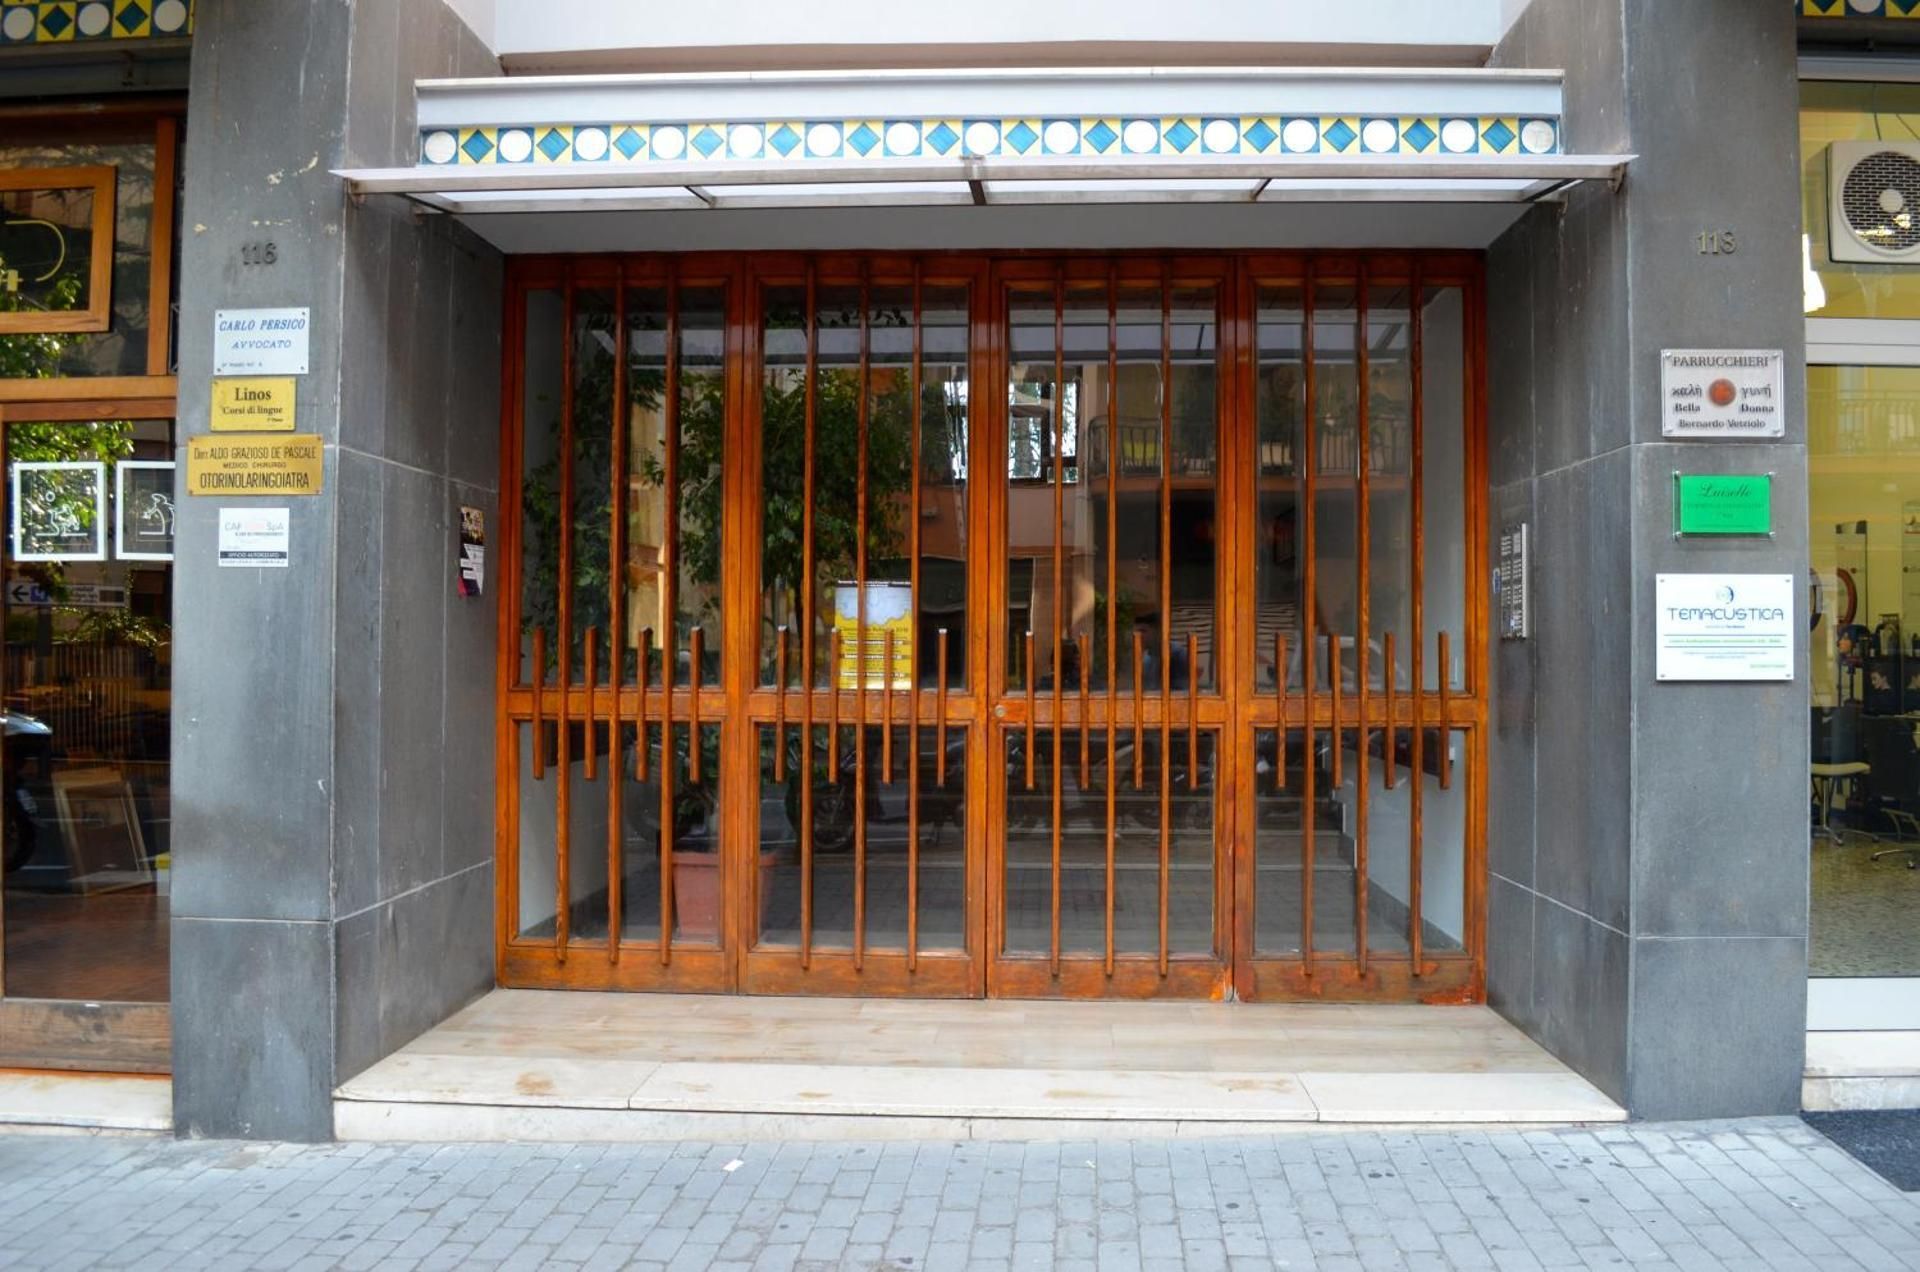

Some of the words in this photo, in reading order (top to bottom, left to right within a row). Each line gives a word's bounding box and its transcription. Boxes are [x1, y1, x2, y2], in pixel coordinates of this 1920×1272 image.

[1697, 231, 1736, 255] 118
[219, 319, 255, 332] CARLO
[260, 318, 306, 331] PERSICO
[231, 339, 292, 350] AVVOCATO
[1672, 355, 1770, 368] PARRUCCHIERI
[234, 387, 272, 401] Linos
[223, 405, 245, 415] Corsi
[246, 404, 256, 415] di
[256, 404, 284, 417] lingue
[1674, 402, 1701, 414] Bella
[1739, 402, 1775, 414] Donna
[1678, 419, 1725, 430] Bernardo
[209, 446, 229, 460] ALDO
[231, 446, 269, 460] GRAZIOSO
[270, 446, 282, 459] DE
[283, 445, 317, 460] PASCALE
[199, 471, 310, 489] OTORINOLARINGOIATRA
[1666, 607, 1785, 621] TEMACUSTICA
